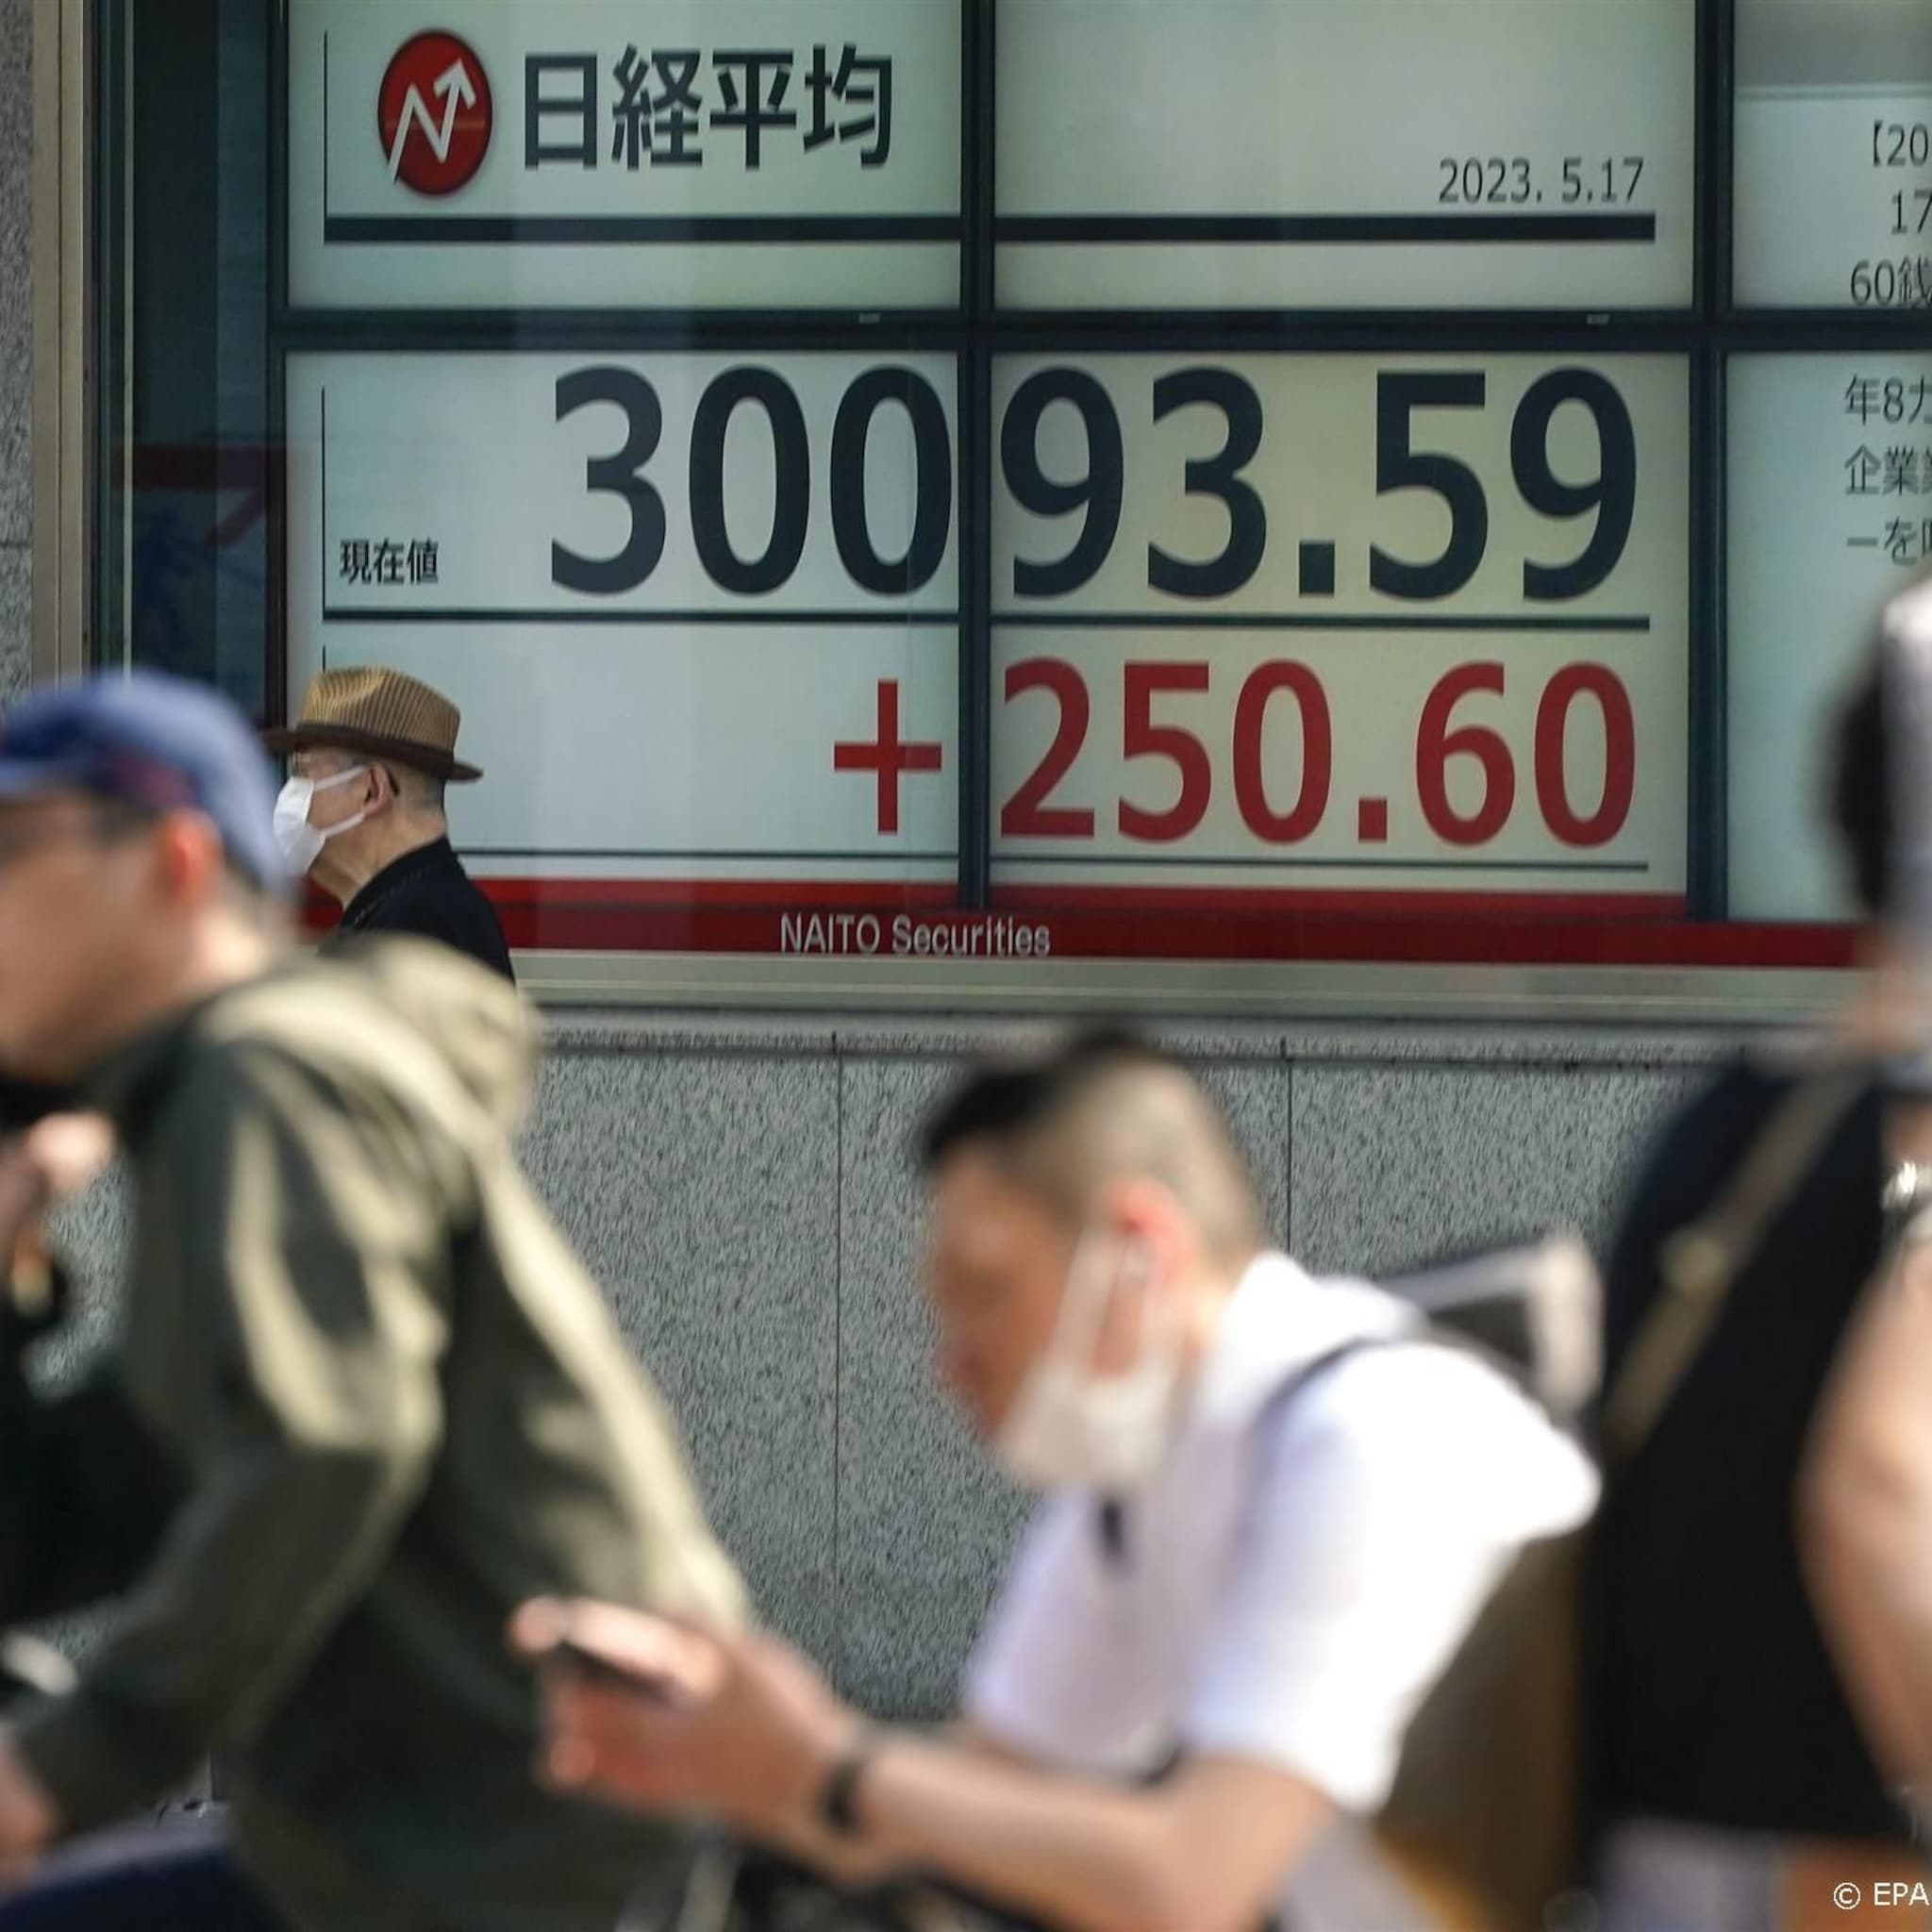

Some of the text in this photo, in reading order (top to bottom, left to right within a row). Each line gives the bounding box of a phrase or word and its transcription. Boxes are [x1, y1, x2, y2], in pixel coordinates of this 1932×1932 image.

[525, 43, 892, 170] 日経平均
[551, 366, 1637, 603] 30093.59
[340, 537, 439, 585] 現在値
[780, 913, 1050, 958] NAITO Securities
